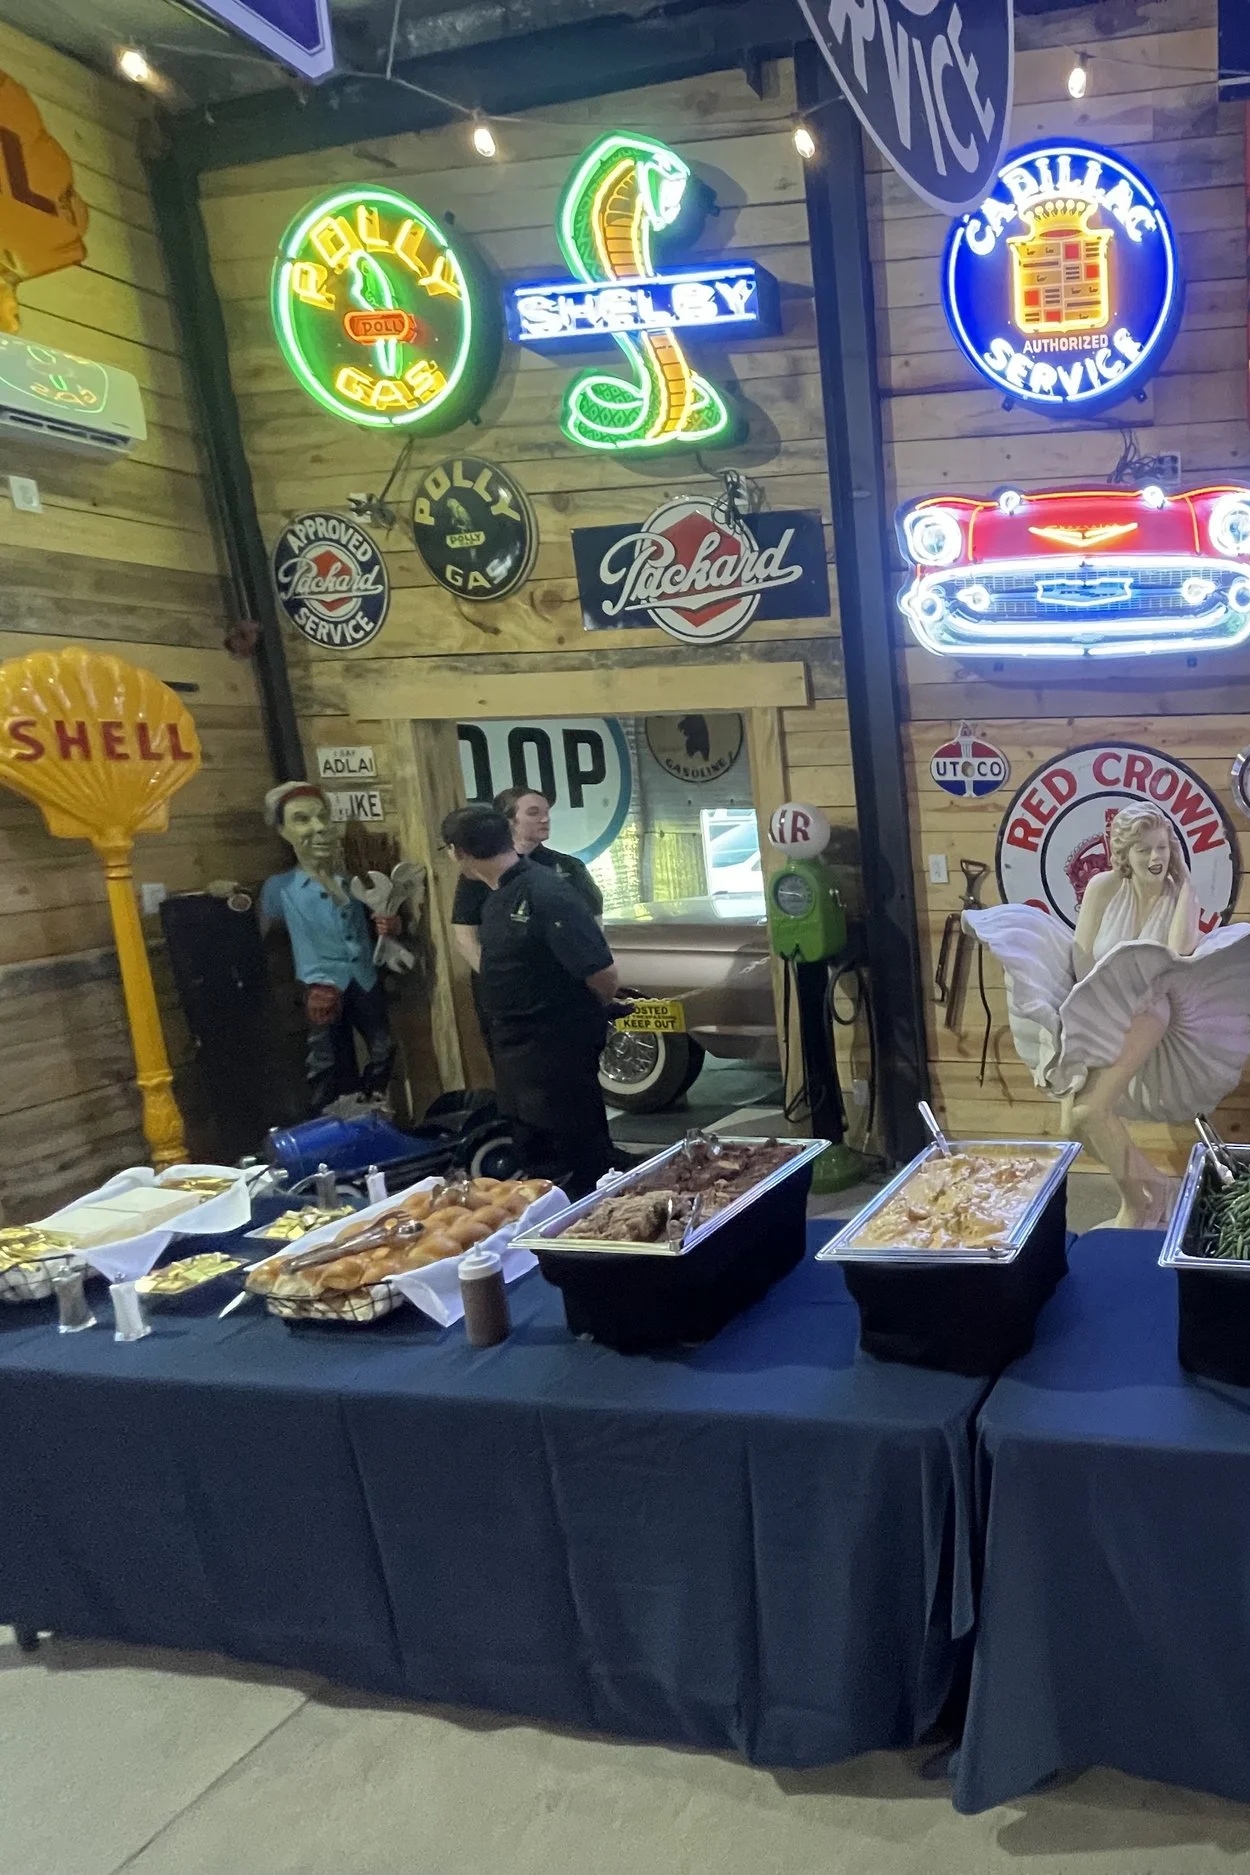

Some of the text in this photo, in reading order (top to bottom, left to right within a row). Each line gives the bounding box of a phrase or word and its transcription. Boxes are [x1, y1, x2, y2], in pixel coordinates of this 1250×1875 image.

[963, 154, 1158, 257] CADILLAC
[292, 205, 465, 310] POLLY
[517, 279, 757, 336] SHELBY
[984, 328, 1145, 396] SERVICE
[1023, 334, 1109, 355] AUTHORIZED
[335, 361, 448, 410] GAS
[414, 460, 521, 526] POLLY
[286, 517, 373, 562] APPROVED
[449, 533, 482, 545] POLLY
[278, 557, 384, 600] Packard
[600, 529, 803, 616] Packard
[294, 607, 375, 644] SERVICE
[9, 719, 193, 761] SHELL
[323, 758, 374, 774] ADLAI
[665, 757, 727, 778] GASOLINE
[350, 794, 381, 818] IKE
[1006, 751, 1226, 855] RED CROWN
[624, 1019, 676, 1029] KEEP OUT
[634, 1006, 668, 1014] OSTED
